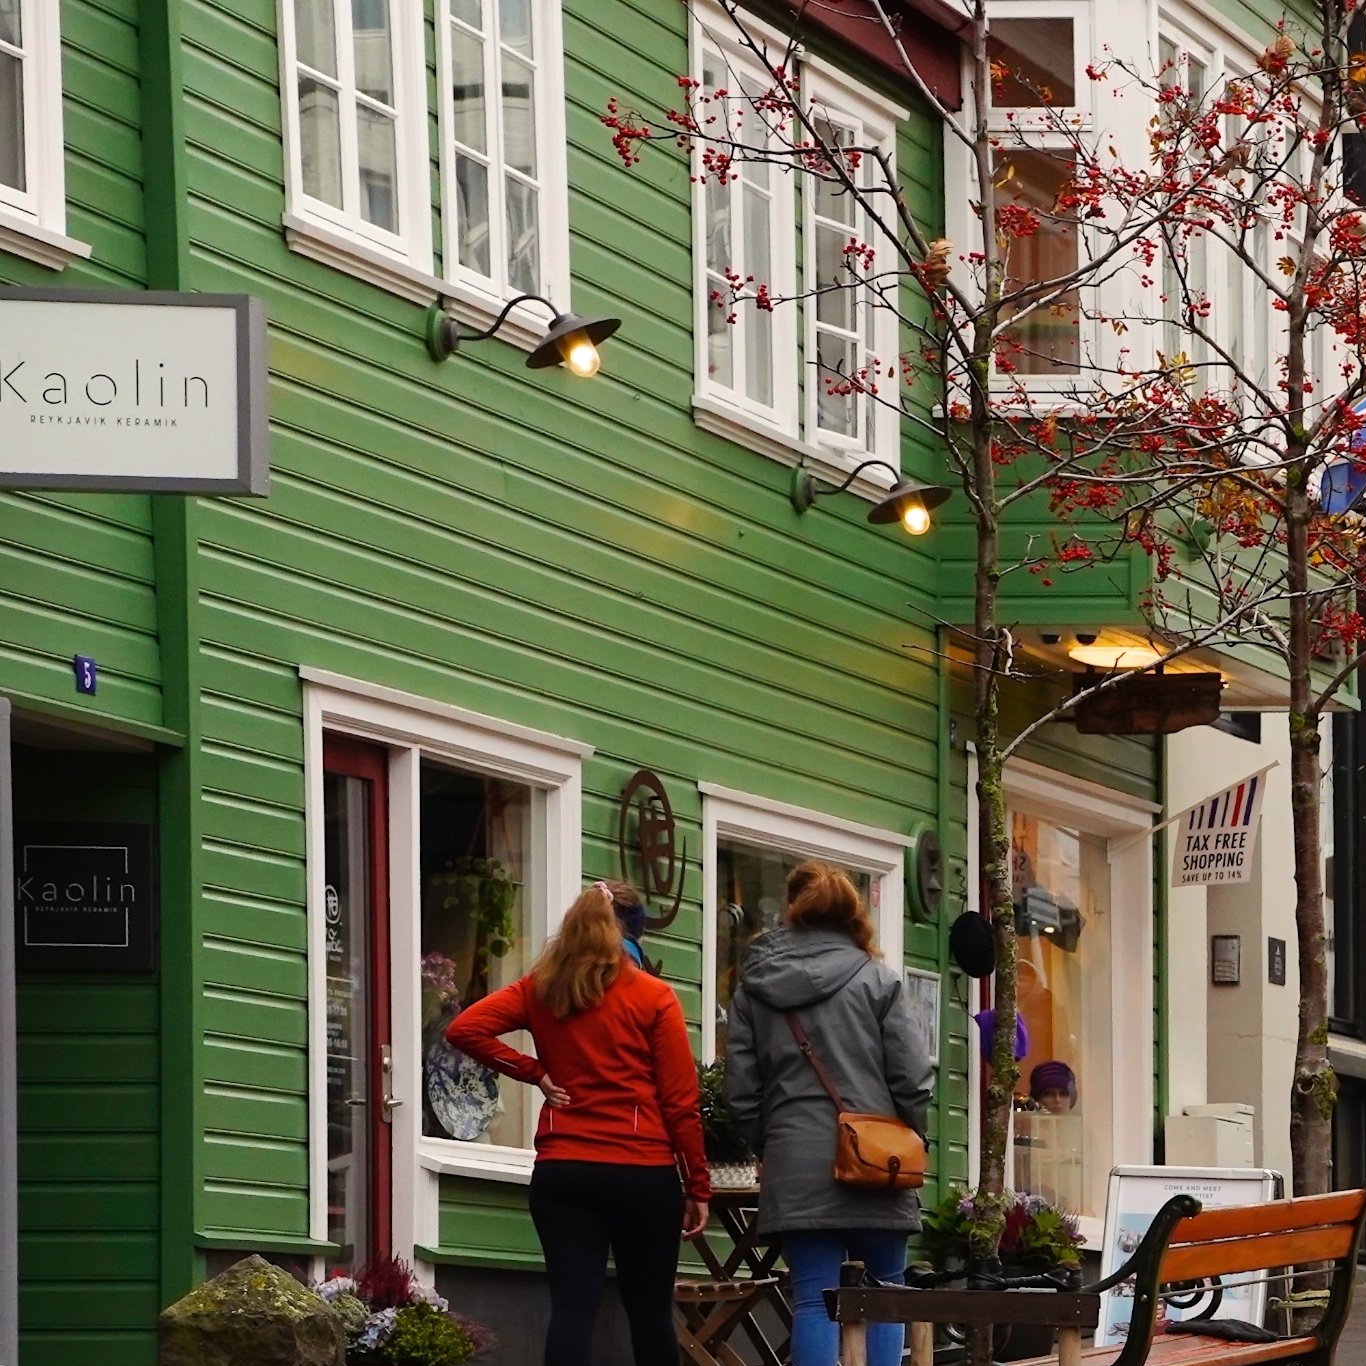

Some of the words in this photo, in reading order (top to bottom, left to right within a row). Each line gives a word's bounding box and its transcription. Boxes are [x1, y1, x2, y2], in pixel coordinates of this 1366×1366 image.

[0, 359, 208, 408] Kaolin
[30, 414, 107, 425] REYKJAVIK
[116, 417, 178, 428] KERAMIK
[1186, 834, 1211, 852] TAX
[1214, 831, 1248, 850] FREE
[1182, 851, 1245, 871] SHOPPING
[1182, 872, 1200, 884] SAVE
[1202, 871, 1212, 881] UP
[1215, 871, 1225, 880] TO
[1227, 869, 1243, 880] 14%
[16, 875, 136, 903] Kaolin
